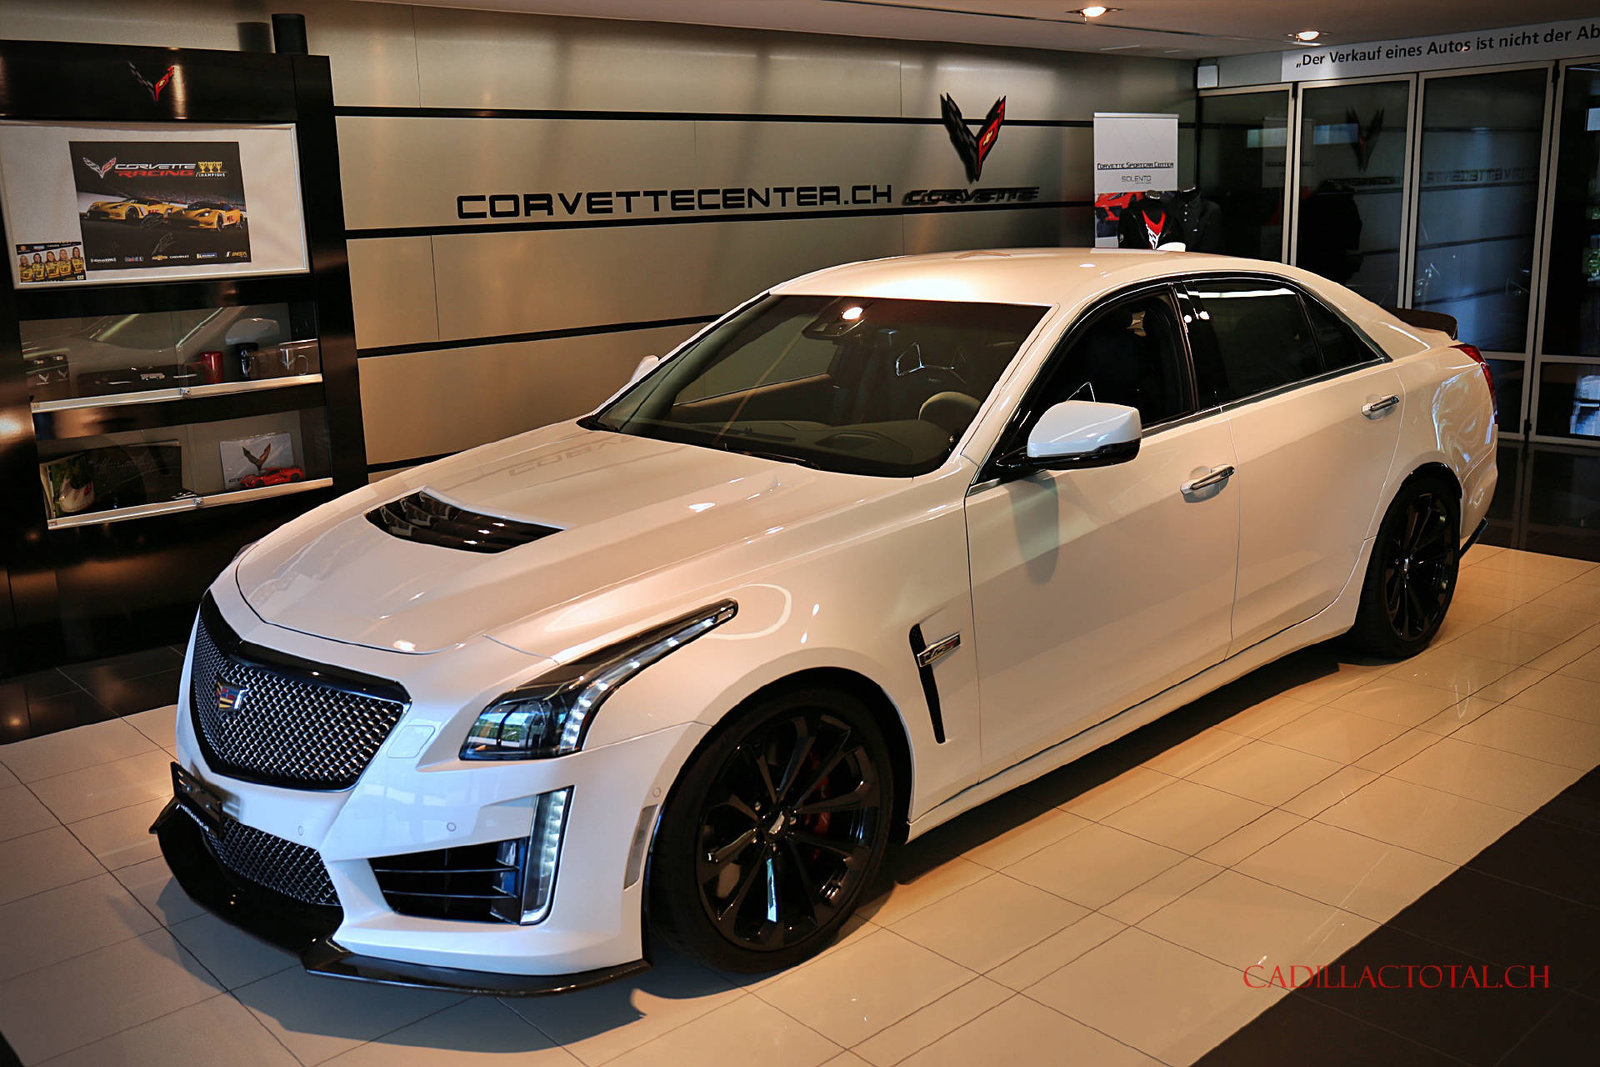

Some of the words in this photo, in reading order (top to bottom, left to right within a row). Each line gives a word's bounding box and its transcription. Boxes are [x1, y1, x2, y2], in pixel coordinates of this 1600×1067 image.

[1329, 46, 1382, 63] Verkauf
[1385, 45, 1422, 59] eines
[1426, 40, 1471, 56] Autos
[1476, 36, 1494, 50] ist
[1499, 31, 1540, 48] nicht
[1543, 28, 1572, 43] der
[118, 170, 195, 178] RACING
[456, 184, 892, 220] CORVETTECENTER.CH
[901, 187, 1040, 206] CORVETTE
